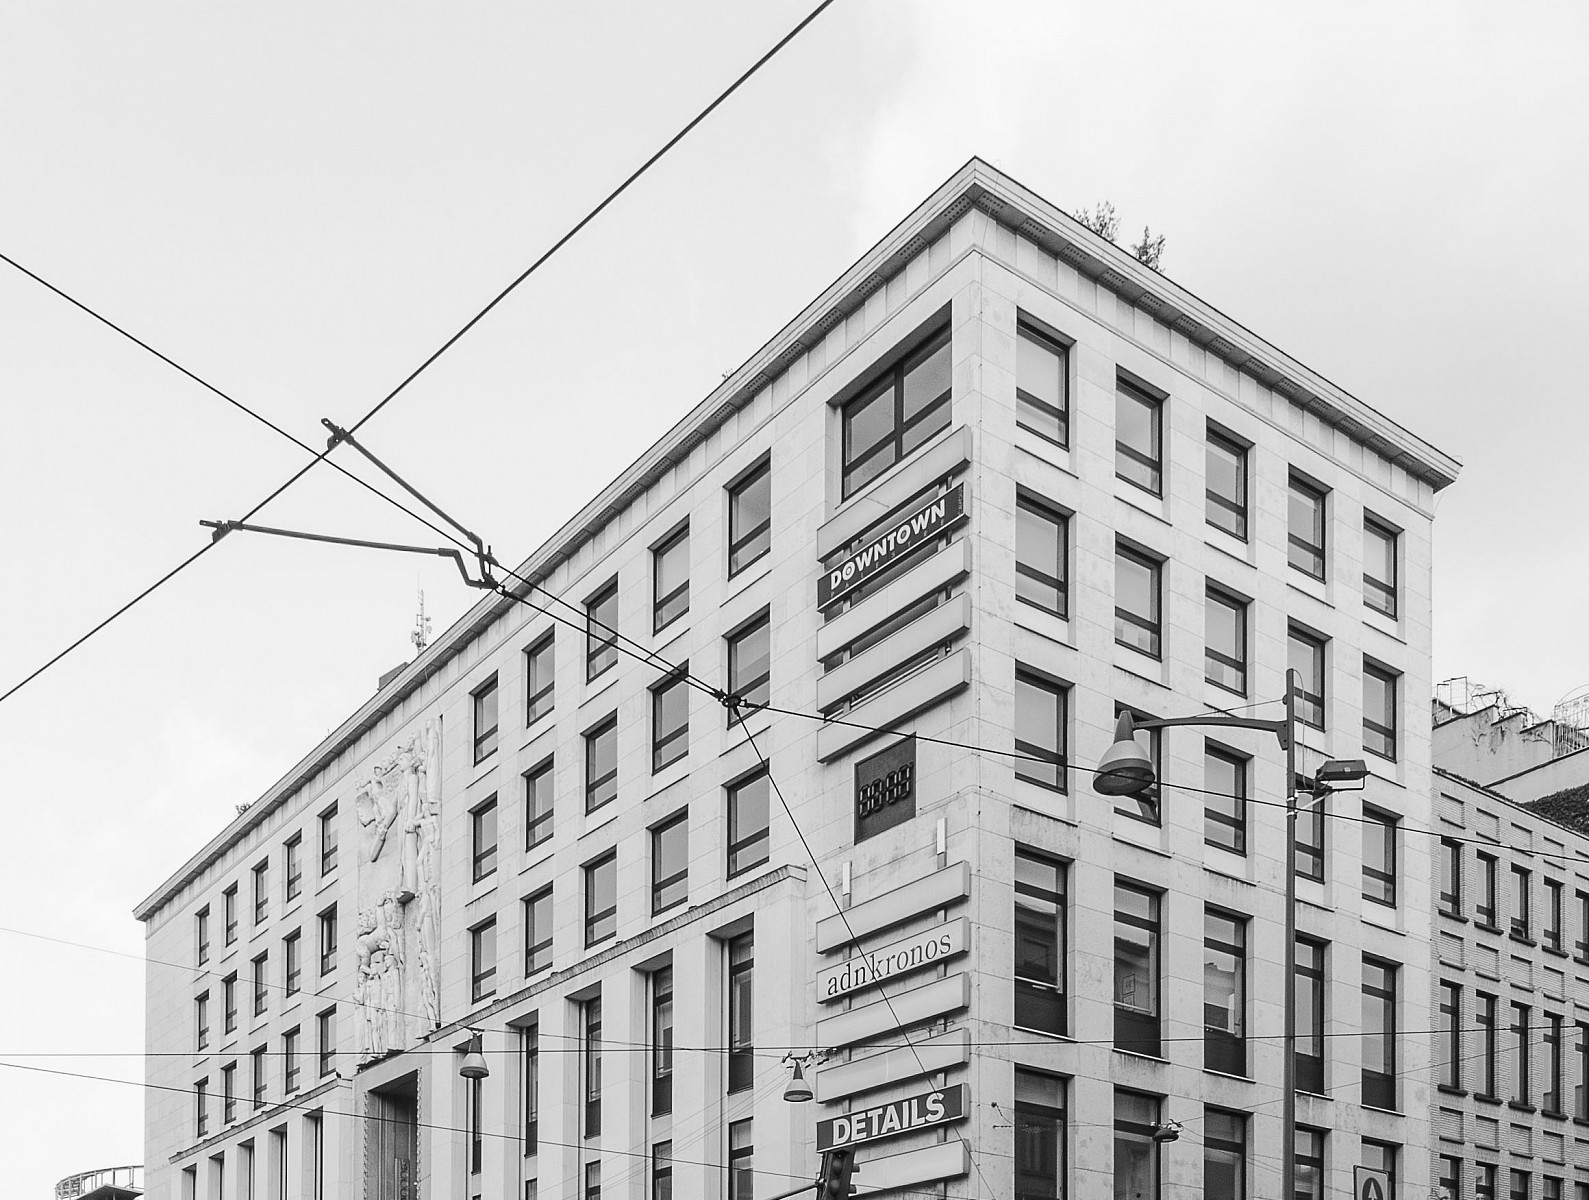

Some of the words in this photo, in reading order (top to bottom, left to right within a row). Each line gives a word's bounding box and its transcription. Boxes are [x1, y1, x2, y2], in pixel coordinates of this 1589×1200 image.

[830, 499, 946, 590] DOWNTOWN
[827, 934, 952, 996] adnkronos
[832, 1092, 945, 1146] DETAILS
